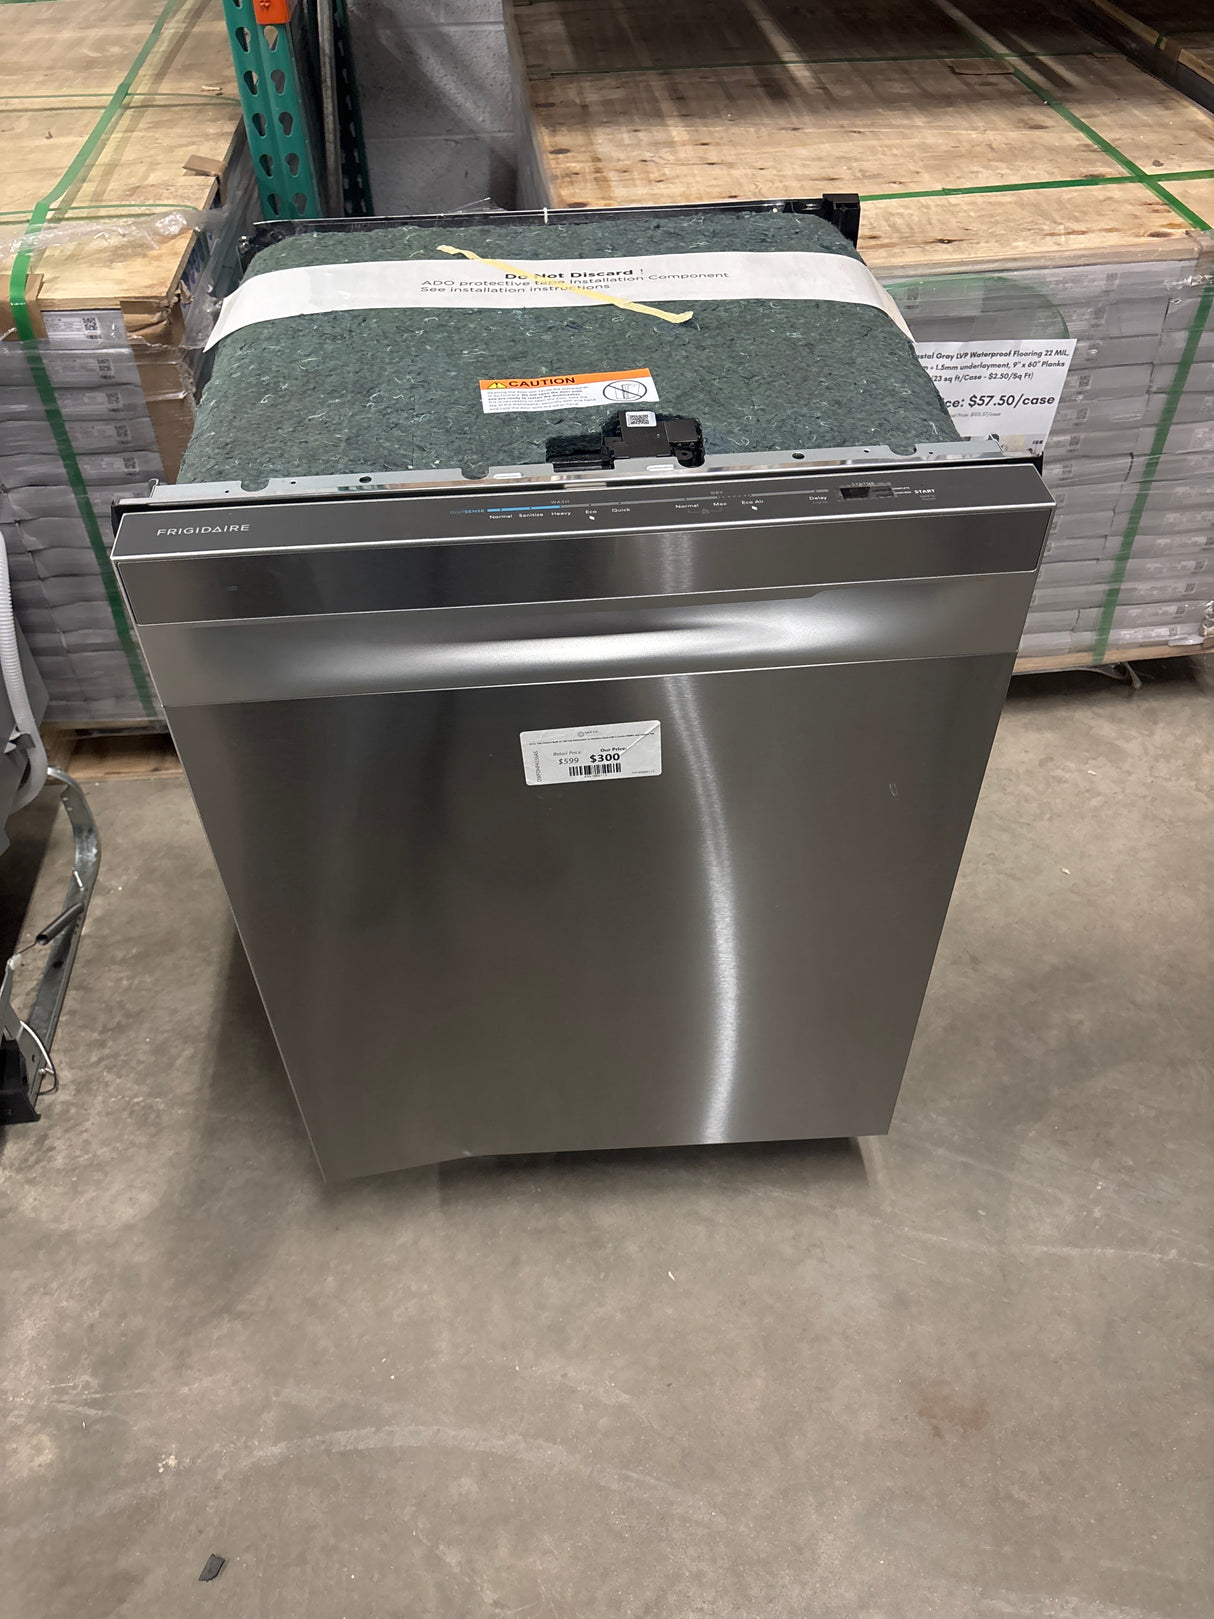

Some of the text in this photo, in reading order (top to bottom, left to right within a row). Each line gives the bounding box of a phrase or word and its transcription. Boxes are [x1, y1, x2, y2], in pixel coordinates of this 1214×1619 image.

[570, 269, 634, 278] Discard
[648, 272, 729, 281] Component
[917, 351, 935, 360] stal
[936, 351, 955, 362] Gray
[956, 352, 969, 360] LVP
[969, 350, 1012, 361] Waterproof
[1012, 350, 1043, 360] Flooring
[1043, 349, 1053, 357] 22
[935, 363, 959, 371] 1.5mm
[959, 361, 1011, 372] underlayment,
[1041, 360, 1066, 368] Planks
[508, 377, 576, 388] CAUTION
[943, 376, 953, 384] sq
[954, 373, 982, 383] ft/Case
[988, 372, 1022, 382] $2.50/Sq
[1022, 372, 1034, 380] Ft)
[944, 393, 1056, 409] ce: $57.50/case
[156, 524, 251, 537] FRIGIDAIRE
[558, 752, 621, 765] $599 $300
